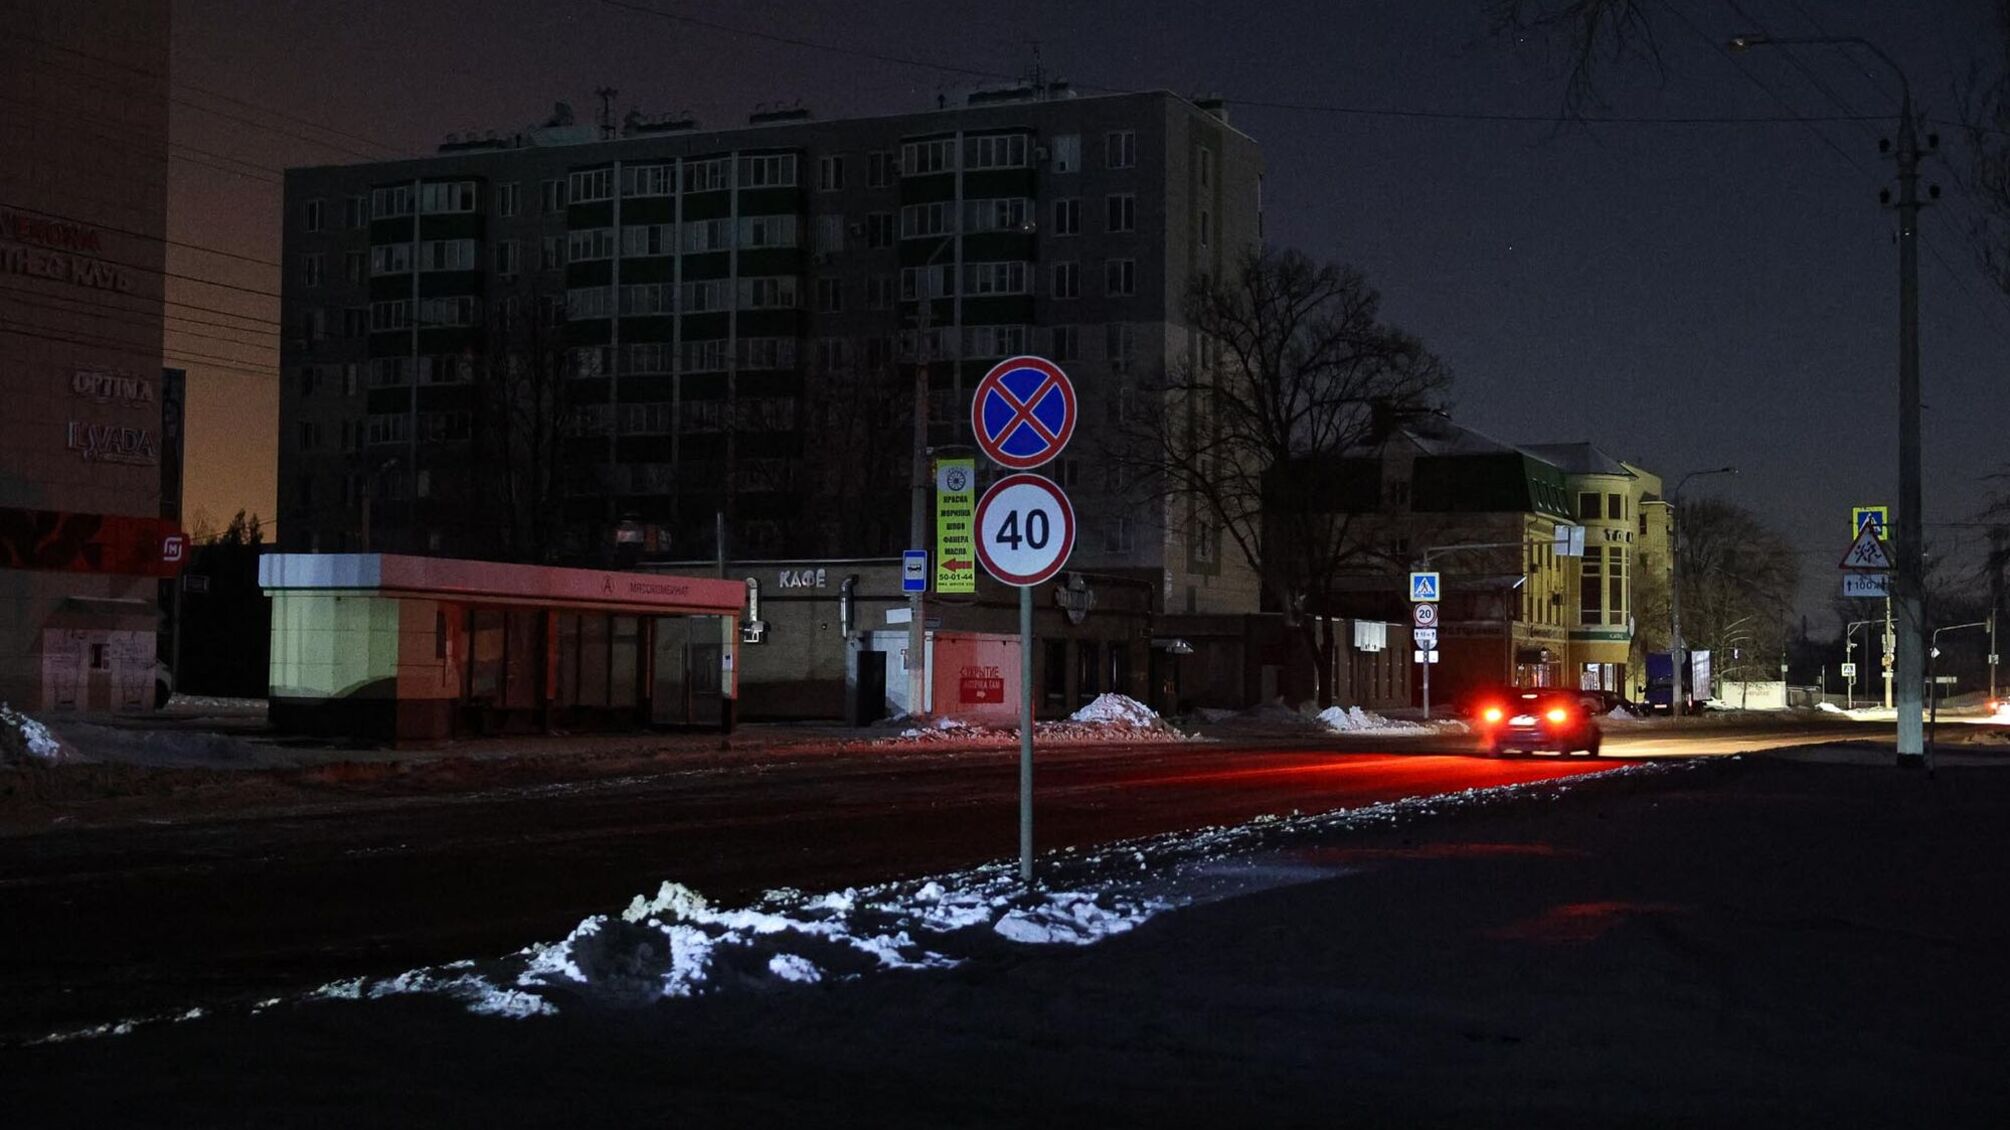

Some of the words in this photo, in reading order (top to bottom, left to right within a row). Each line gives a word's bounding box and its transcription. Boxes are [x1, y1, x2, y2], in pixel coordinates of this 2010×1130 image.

[996, 509, 1049, 550] 40
[779, 568, 826, 588] КАФЕ
[938, 573, 973, 581] 50-01-44
[1855, 581, 1872, 590] 100
[1419, 609, 1431, 619] 20
